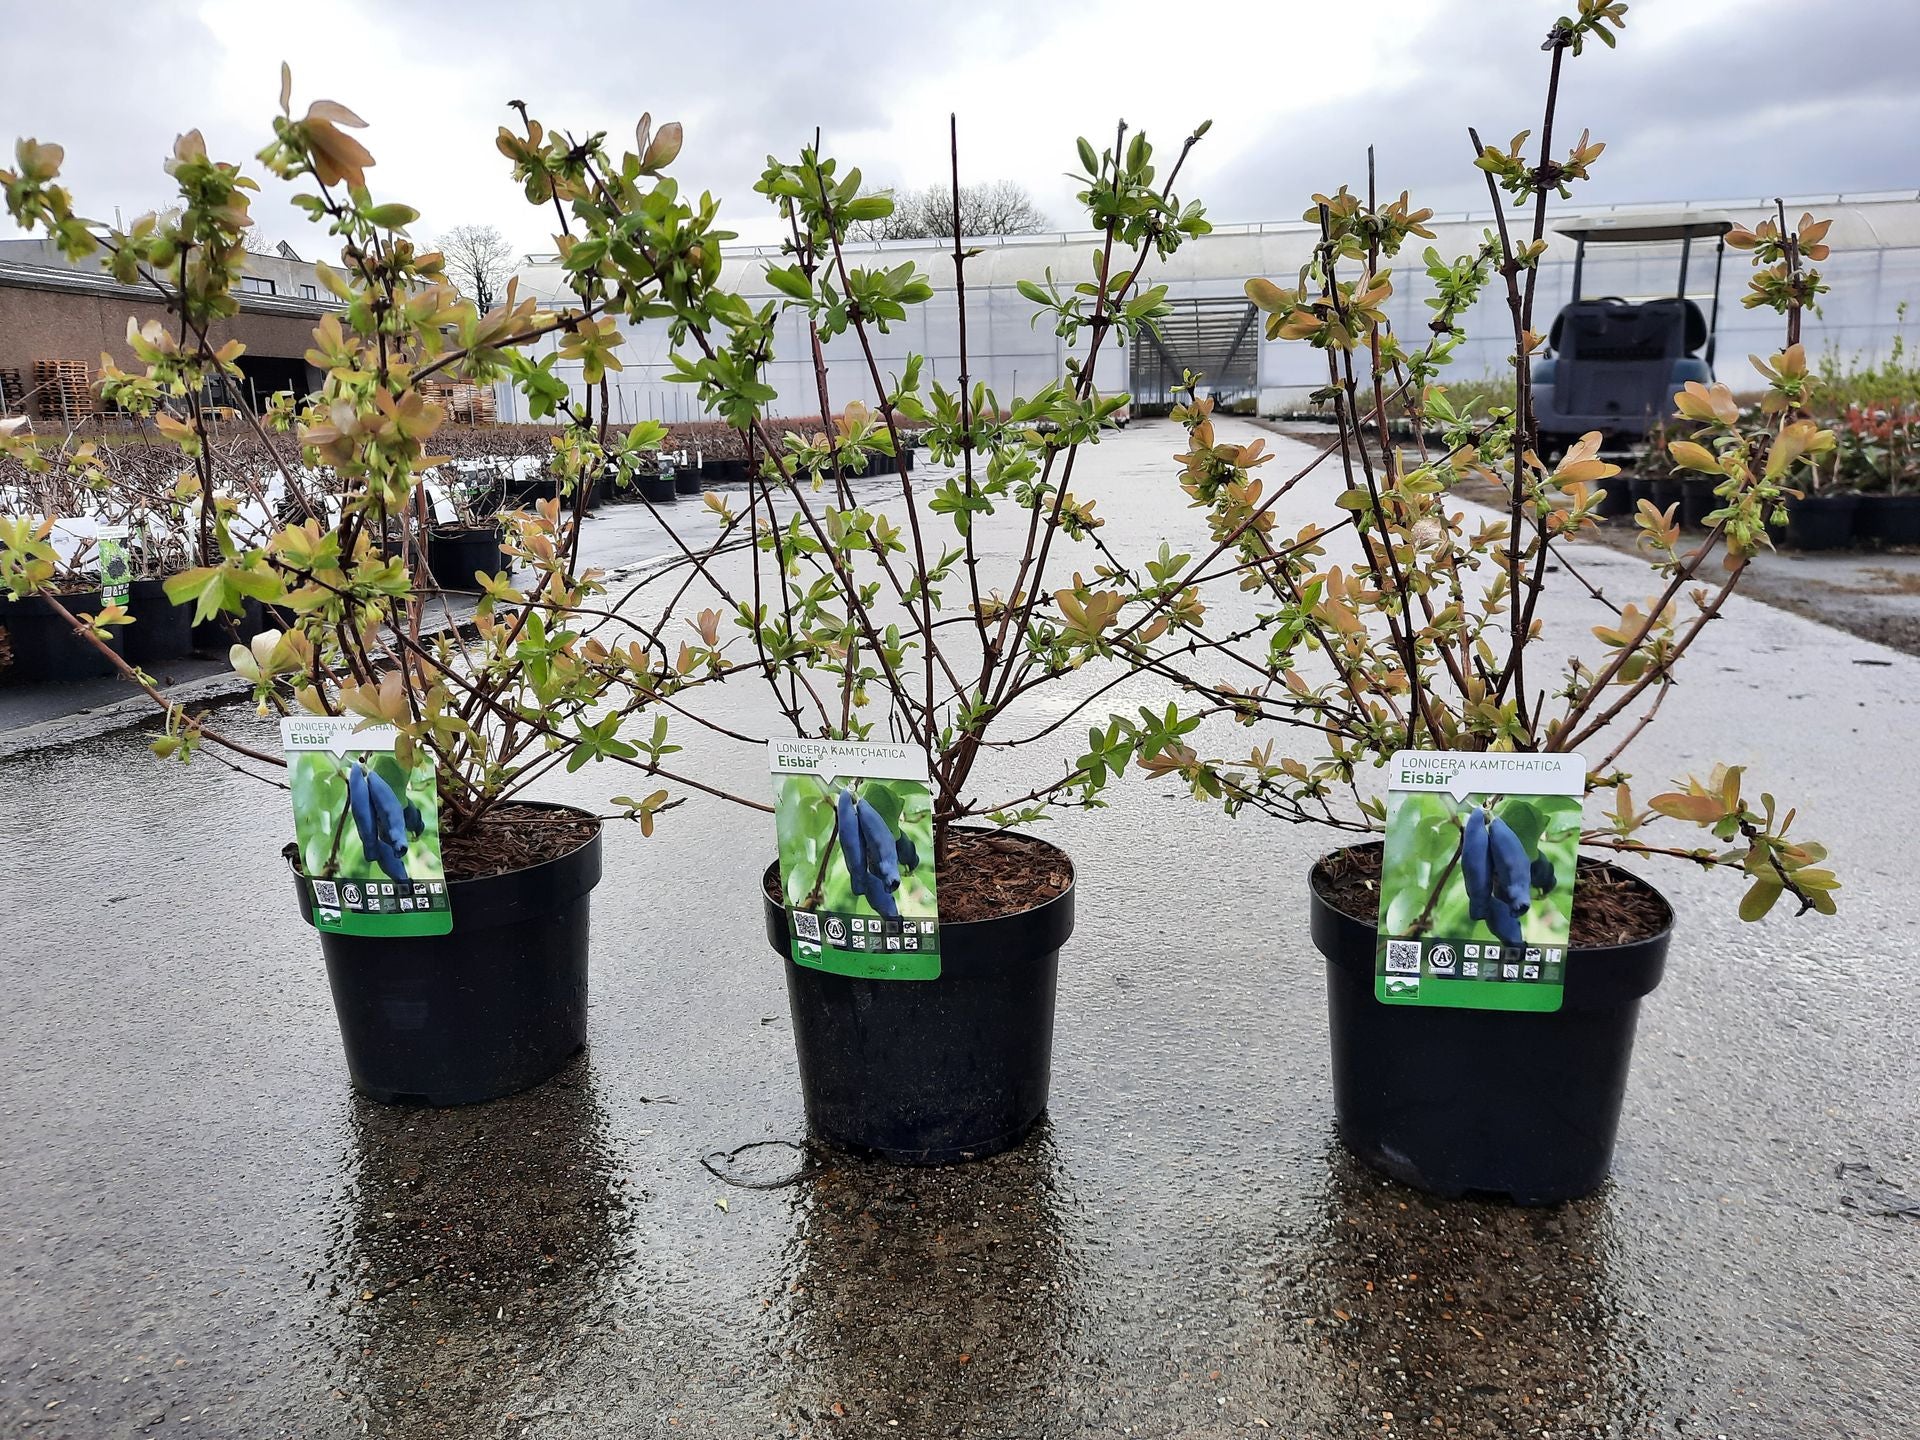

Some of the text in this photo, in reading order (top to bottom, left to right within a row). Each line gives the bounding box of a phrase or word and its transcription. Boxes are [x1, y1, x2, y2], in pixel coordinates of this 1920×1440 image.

[288, 722, 338, 732] LONICERA
[776, 743, 907, 759] LONICERA KAMTCHATICA
[1402, 757, 1562, 772] LONICERA KAMTCHATICA
[1437, 950, 1448, 962] A
